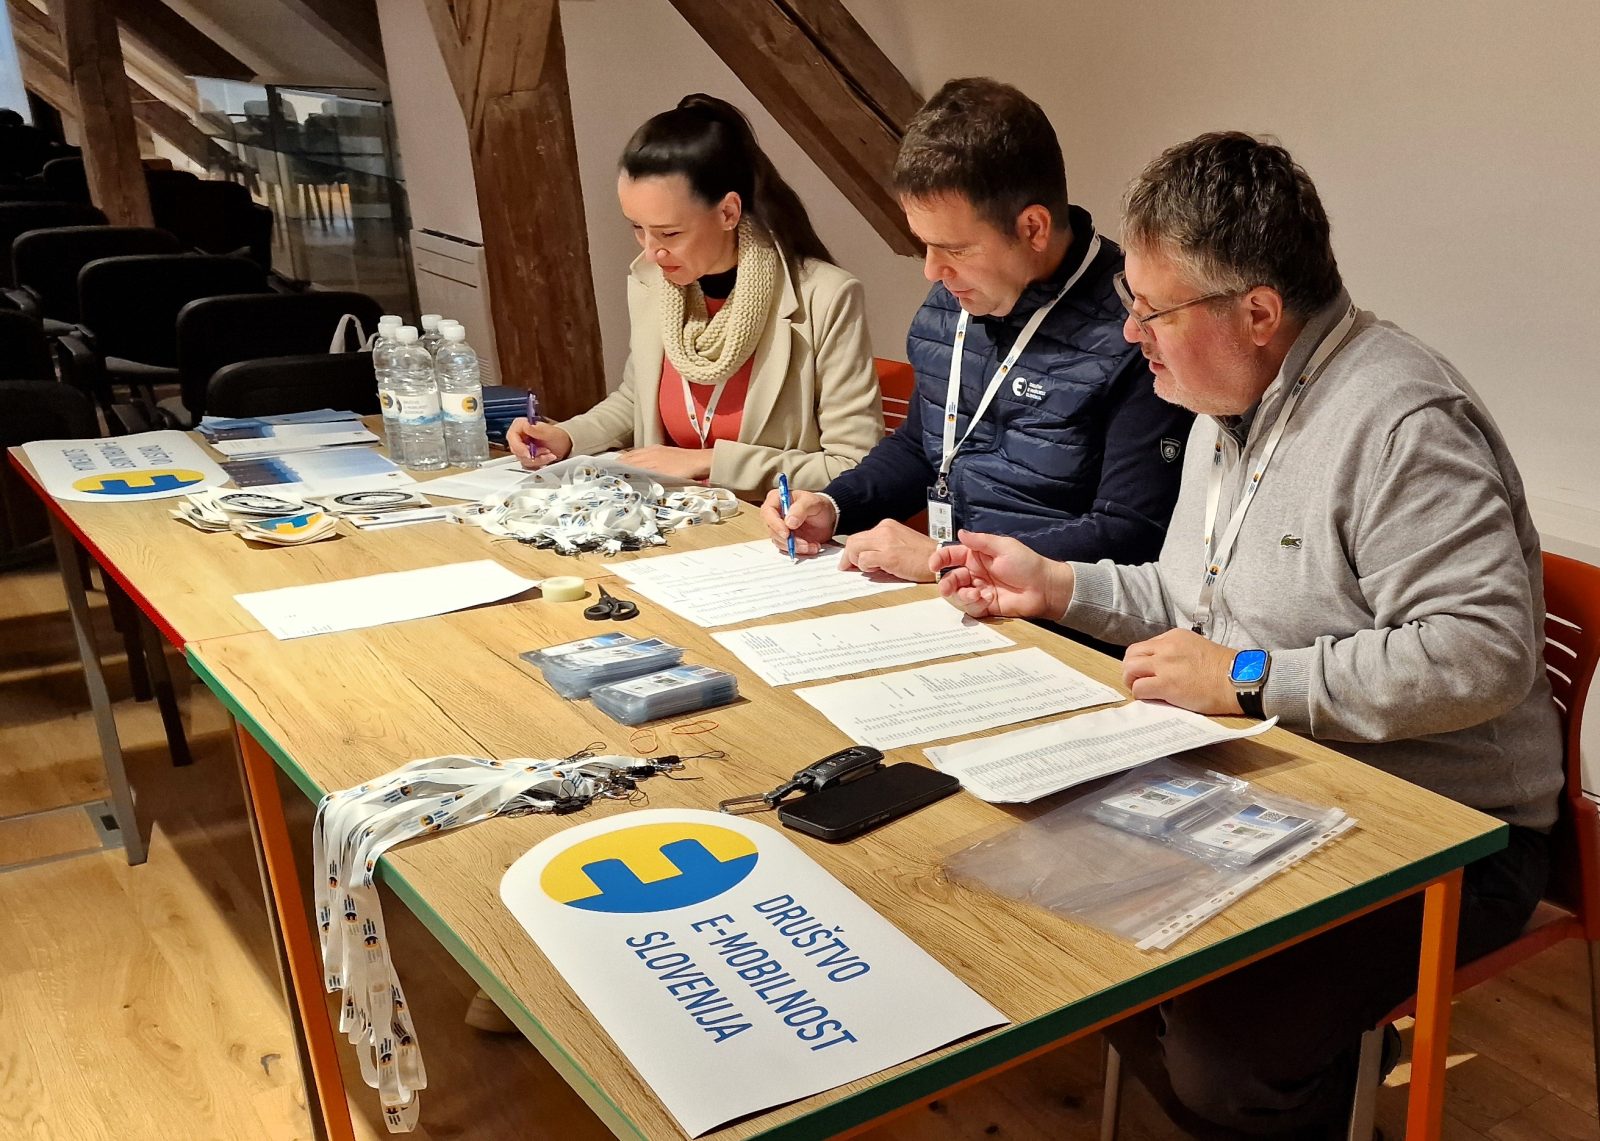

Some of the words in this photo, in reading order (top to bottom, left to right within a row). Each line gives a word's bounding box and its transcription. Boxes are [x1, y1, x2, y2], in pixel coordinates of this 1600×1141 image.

[627, 931, 753, 1043] SLOVENIJA
[690, 913, 859, 1052] E-MOBILNOST
[753, 894, 871, 983] DRUŠTVO
